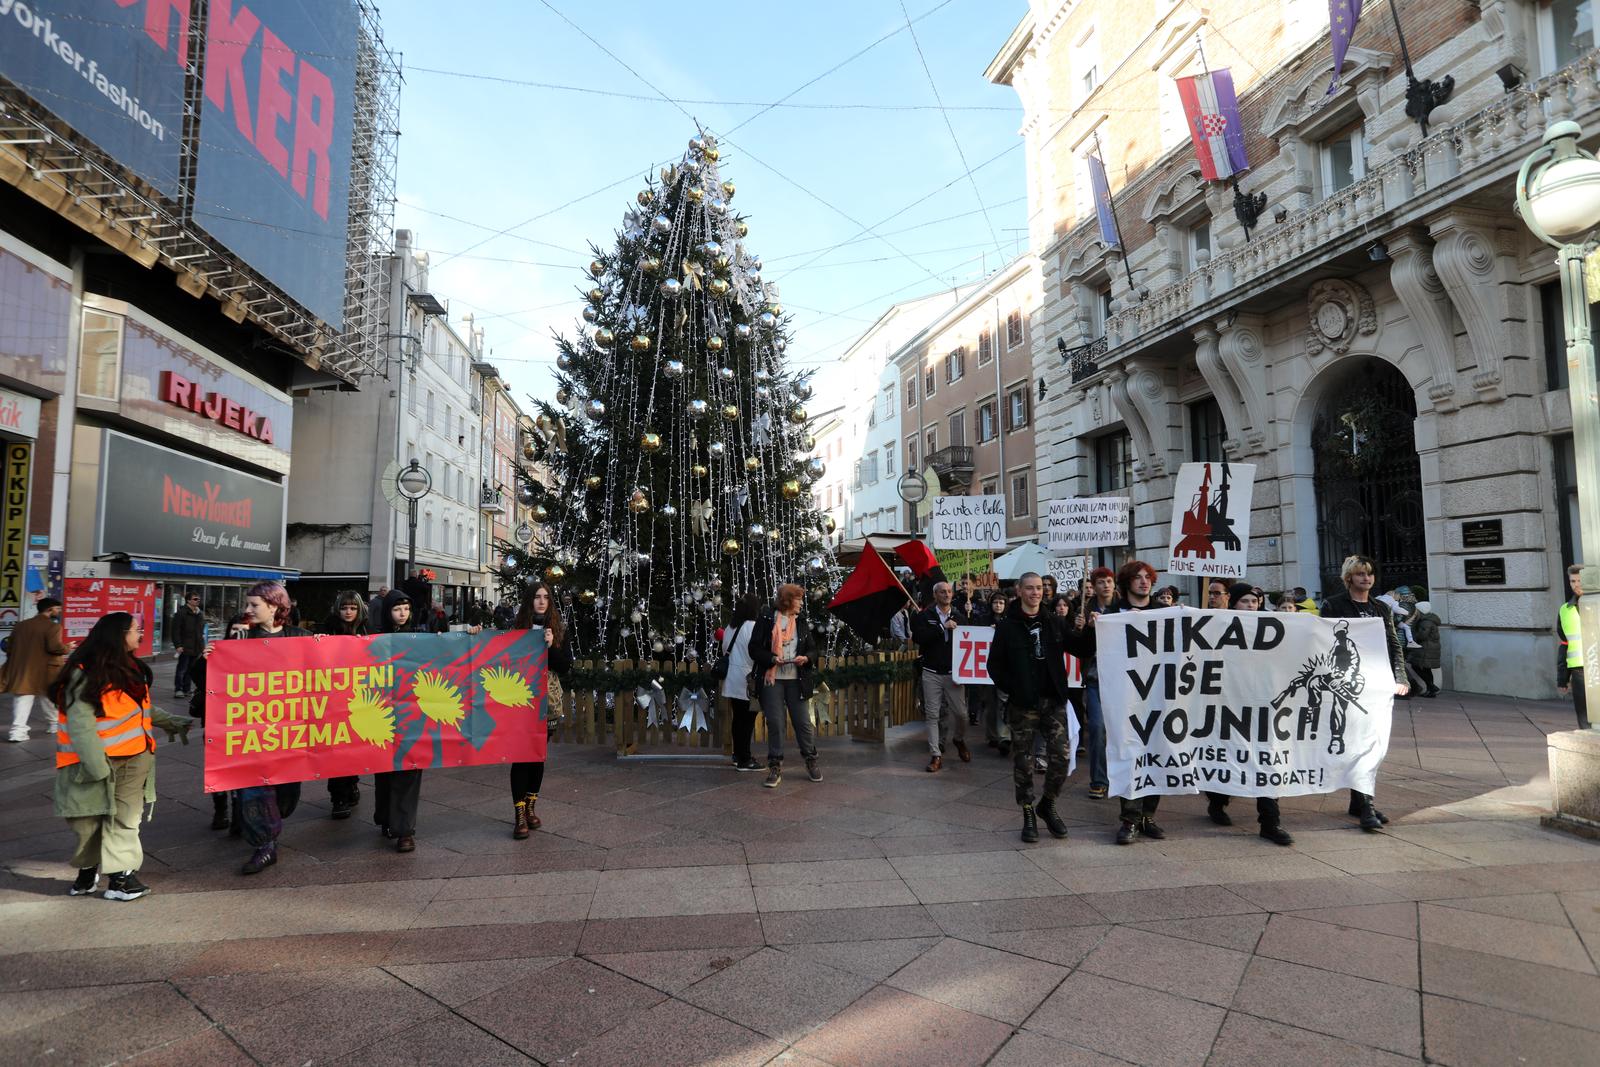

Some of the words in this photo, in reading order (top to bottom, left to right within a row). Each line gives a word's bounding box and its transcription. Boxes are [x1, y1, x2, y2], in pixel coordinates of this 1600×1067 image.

[159, 371, 273, 444] RIJEKA
[9, 447, 27, 520] OTKUP
[935, 497, 951, 516] La
[1048, 515, 1107, 527] NACIONALIZAM
[192, 527, 216, 545] Dress
[214, 531, 229, 550] for
[231, 535, 242, 548] the
[942, 522, 972, 541] BELLA
[975, 522, 1001, 542] CIAO
[2, 528, 21, 603] ZLATA
[1048, 559, 1078, 571] BORBA
[1170, 560, 1195, 572] FIUME
[1125, 615, 1285, 658] NIKAD
[226, 664, 394, 698] UJEDINJENI
[1127, 655, 1224, 701] VIŠE
[226, 696, 328, 727] PROTIV
[1129, 704, 1321, 747] VOJNICI!
[226, 720, 352, 756] FAŠIZMA
[1134, 751, 1191, 770] NIKAD
[1236, 749, 1249, 764] U
[1258, 750, 1289, 766] RAT
[1134, 773, 1156, 791] ZA
[1240, 771, 1246, 785] I
[1256, 768, 1324, 787] BOGATE!
